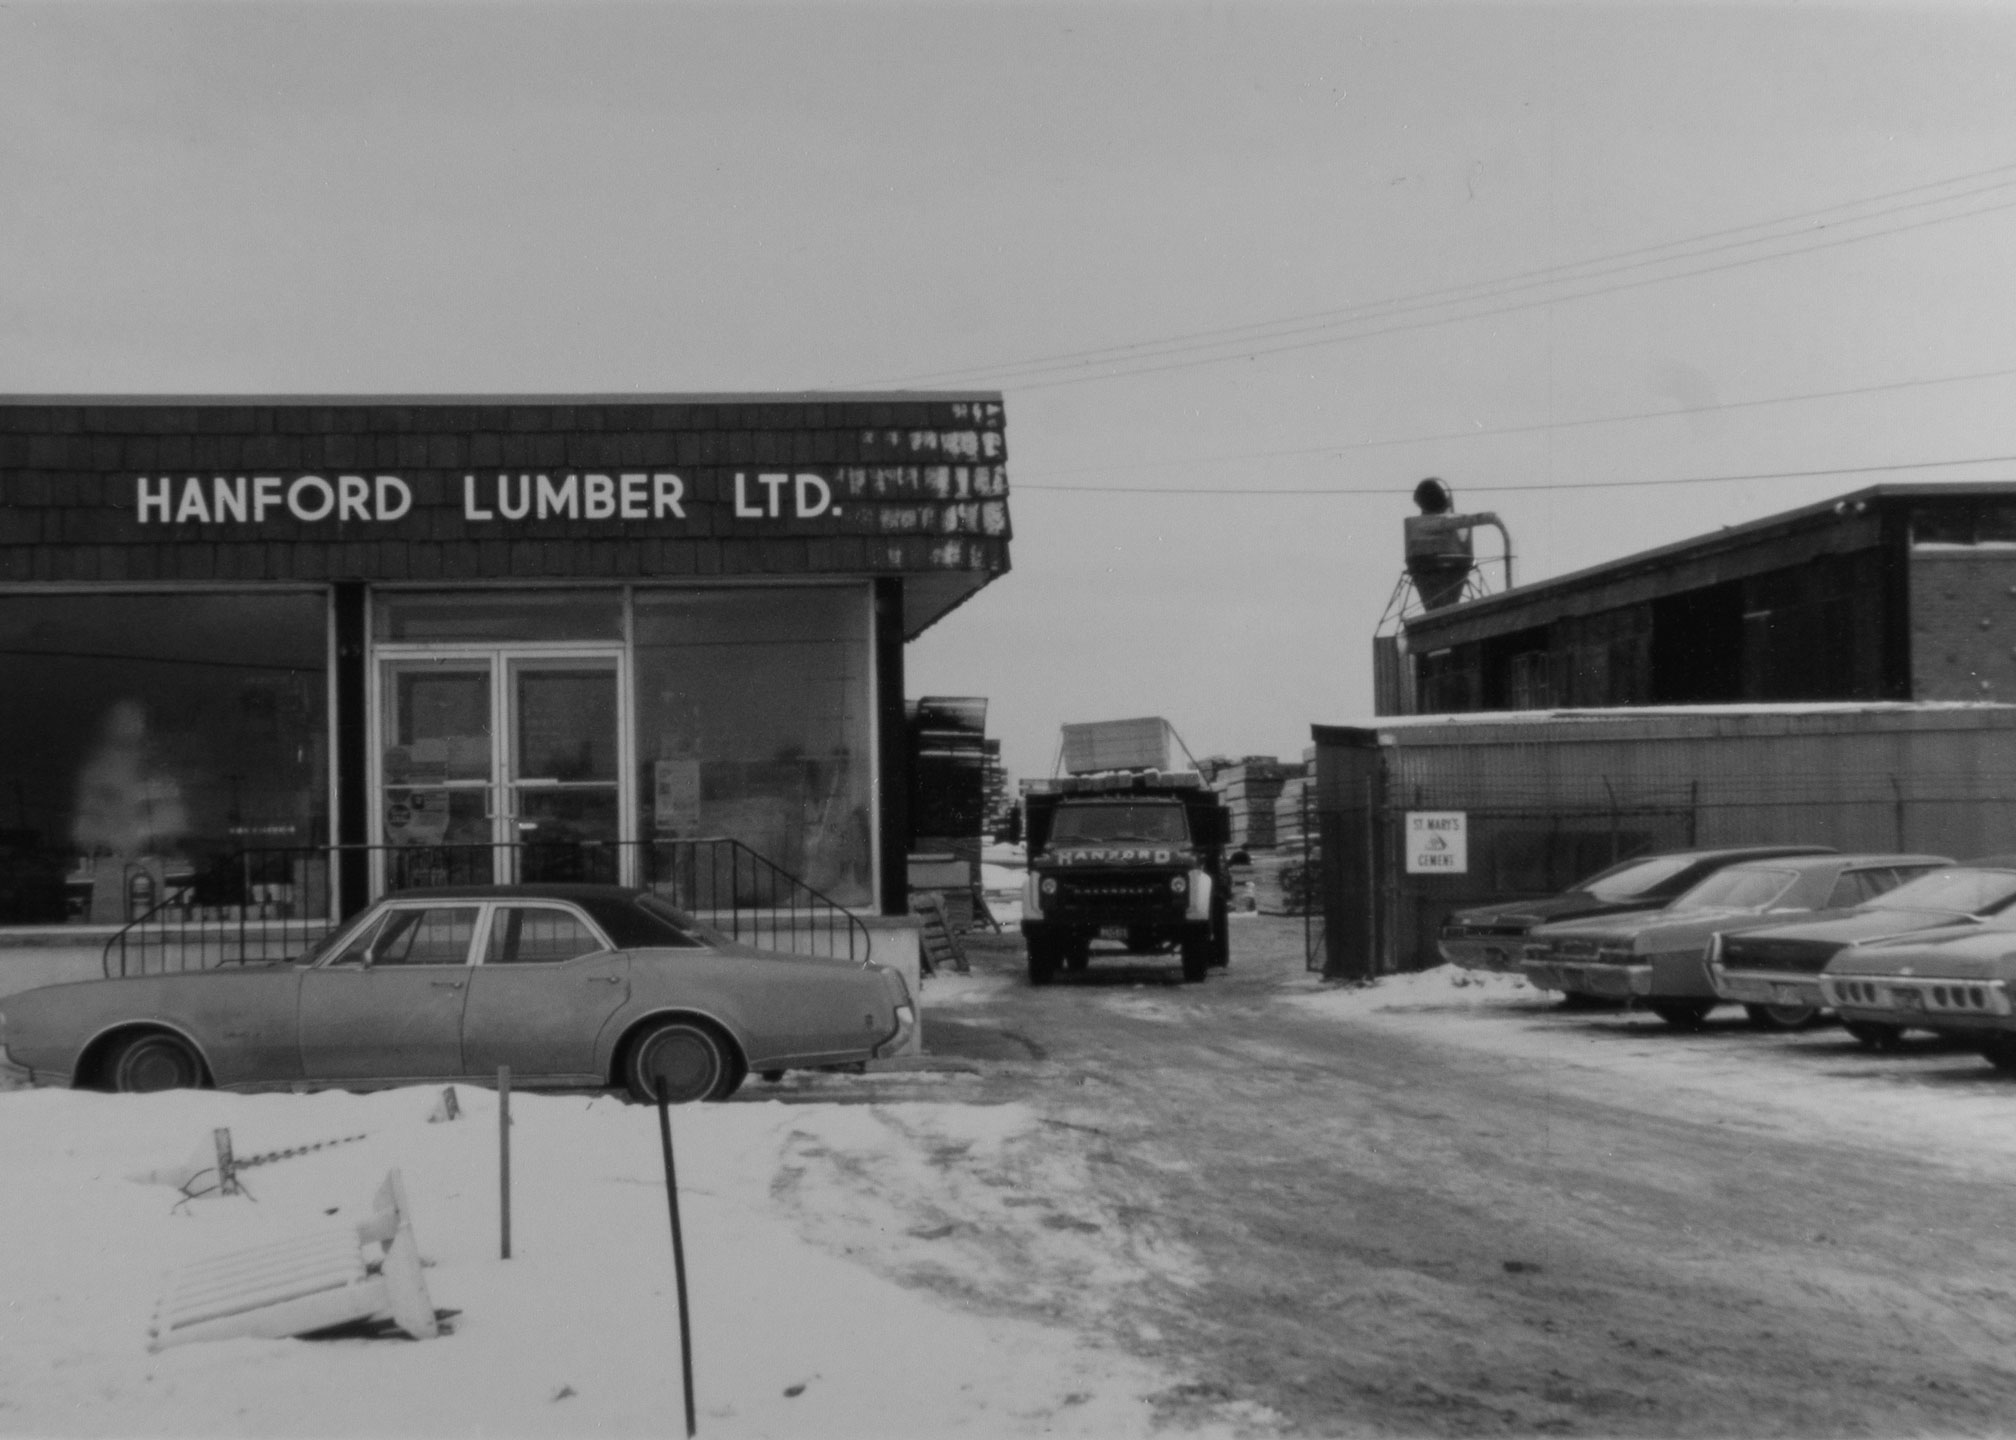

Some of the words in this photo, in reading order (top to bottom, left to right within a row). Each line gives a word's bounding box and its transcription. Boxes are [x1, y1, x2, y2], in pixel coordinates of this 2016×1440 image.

[137, 476, 412, 524] HANFORD
[464, 473, 686, 521] LUMBER
[734, 472, 843, 519] LTD.
[1057, 849, 1171, 867] HANFORD
[1417, 854, 1454, 867] CEMENT
